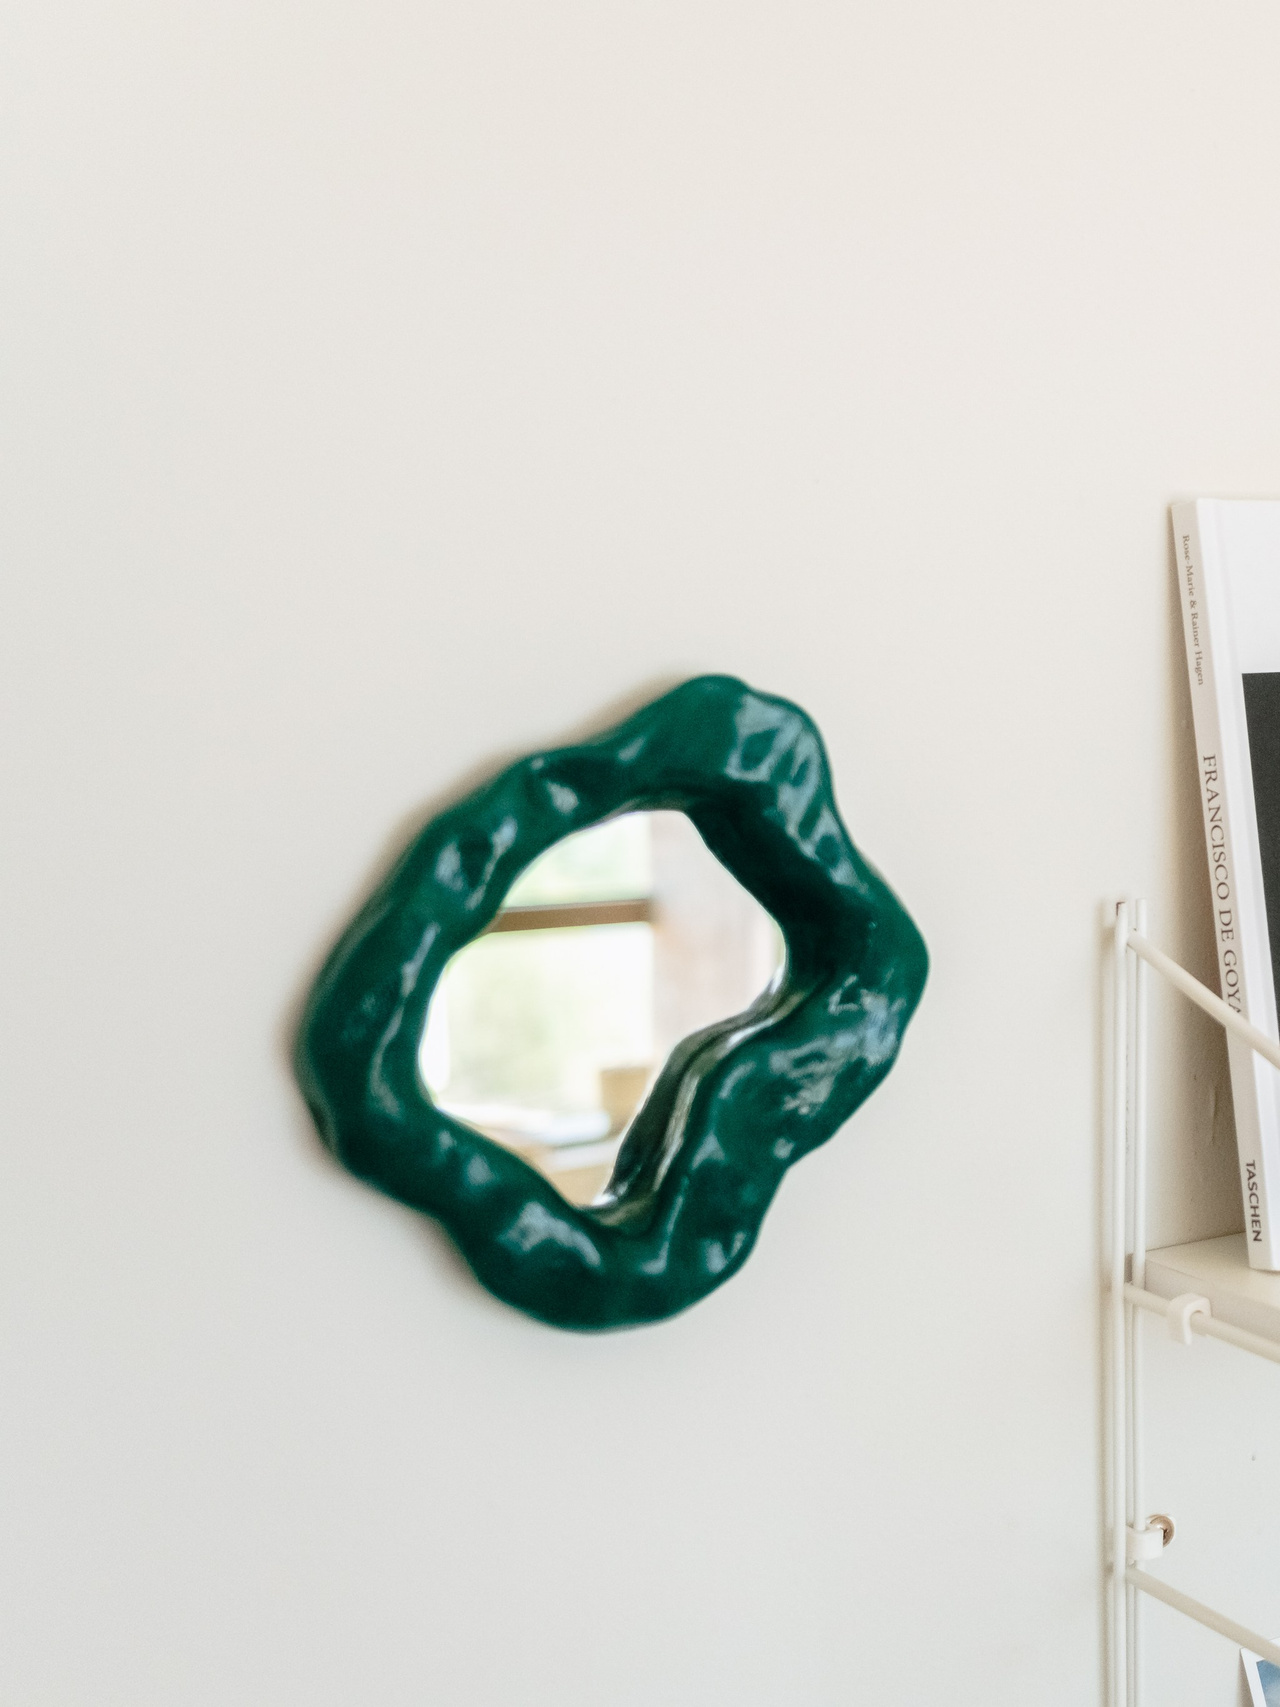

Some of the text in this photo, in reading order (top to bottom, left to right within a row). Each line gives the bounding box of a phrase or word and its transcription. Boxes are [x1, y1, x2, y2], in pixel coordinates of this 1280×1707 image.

[1182, 534, 1204, 686] Rose-Marie & Rainer Hagen
[1202, 753, 1231, 901] FRANCISCO
[1218, 908, 1235, 942] DE
[1245, 1159, 1263, 1242] TASCHEN
